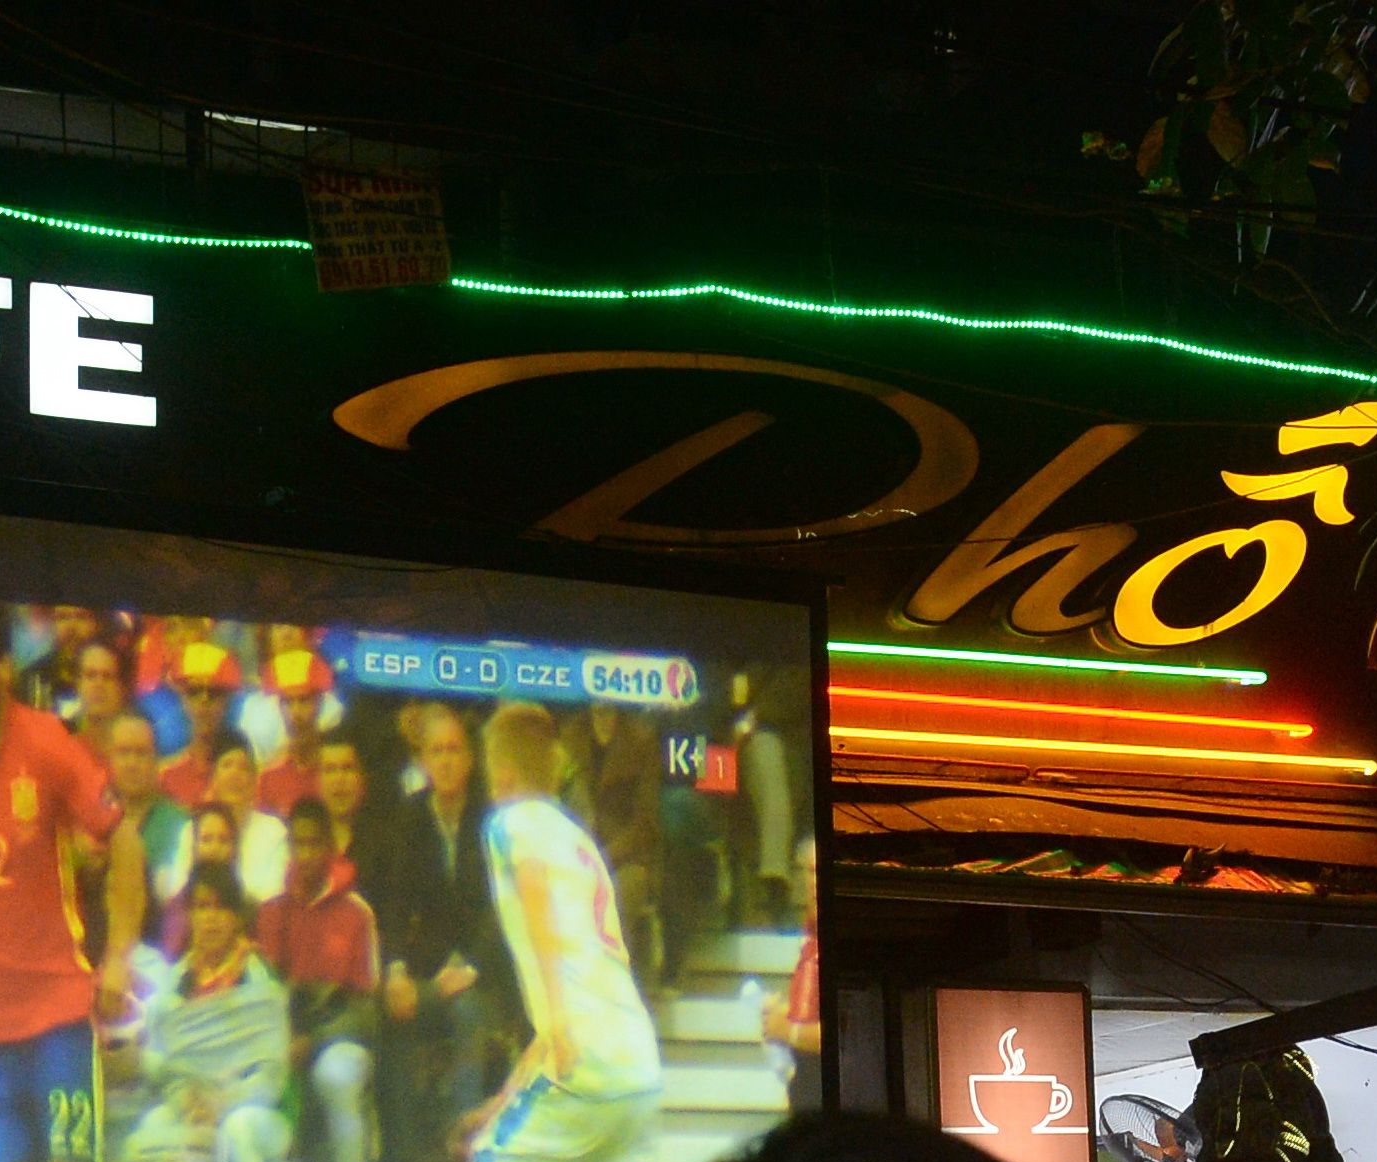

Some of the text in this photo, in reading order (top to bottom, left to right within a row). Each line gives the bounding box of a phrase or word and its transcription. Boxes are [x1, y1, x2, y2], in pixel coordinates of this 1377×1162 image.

[364, 652, 421, 673] ESP
[517, 662, 571, 689] CZE
[591, 668, 663, 696] 54:10
